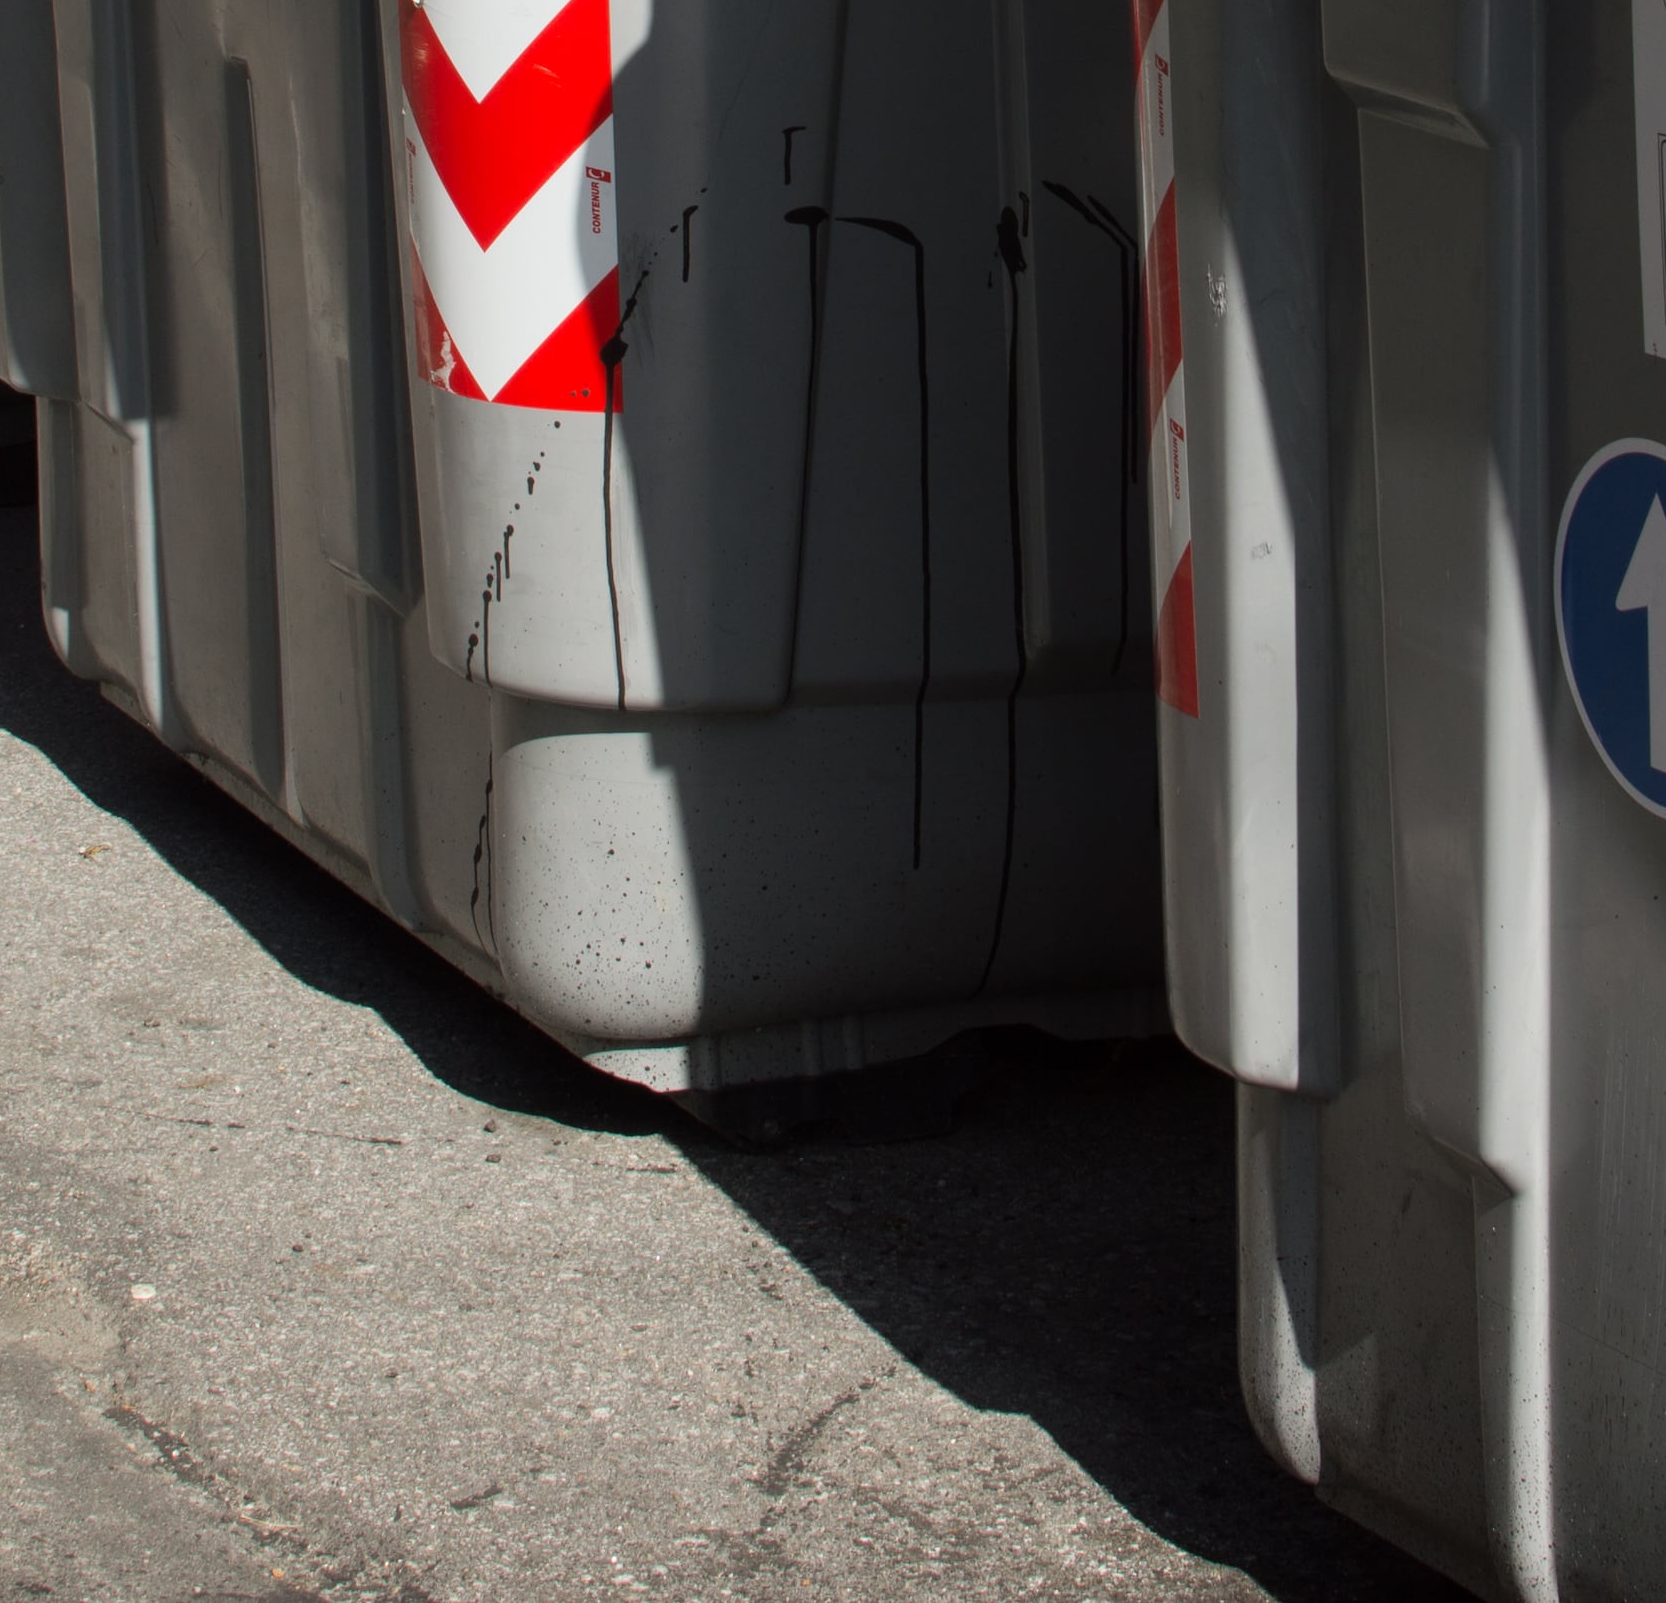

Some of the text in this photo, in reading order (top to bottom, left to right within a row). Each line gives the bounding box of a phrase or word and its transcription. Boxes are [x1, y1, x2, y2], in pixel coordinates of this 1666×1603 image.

[1157, 73, 1165, 136] CONTENUR
[591, 181, 601, 234] CONTENUR
[1172, 437, 1181, 500] CONTENUR
